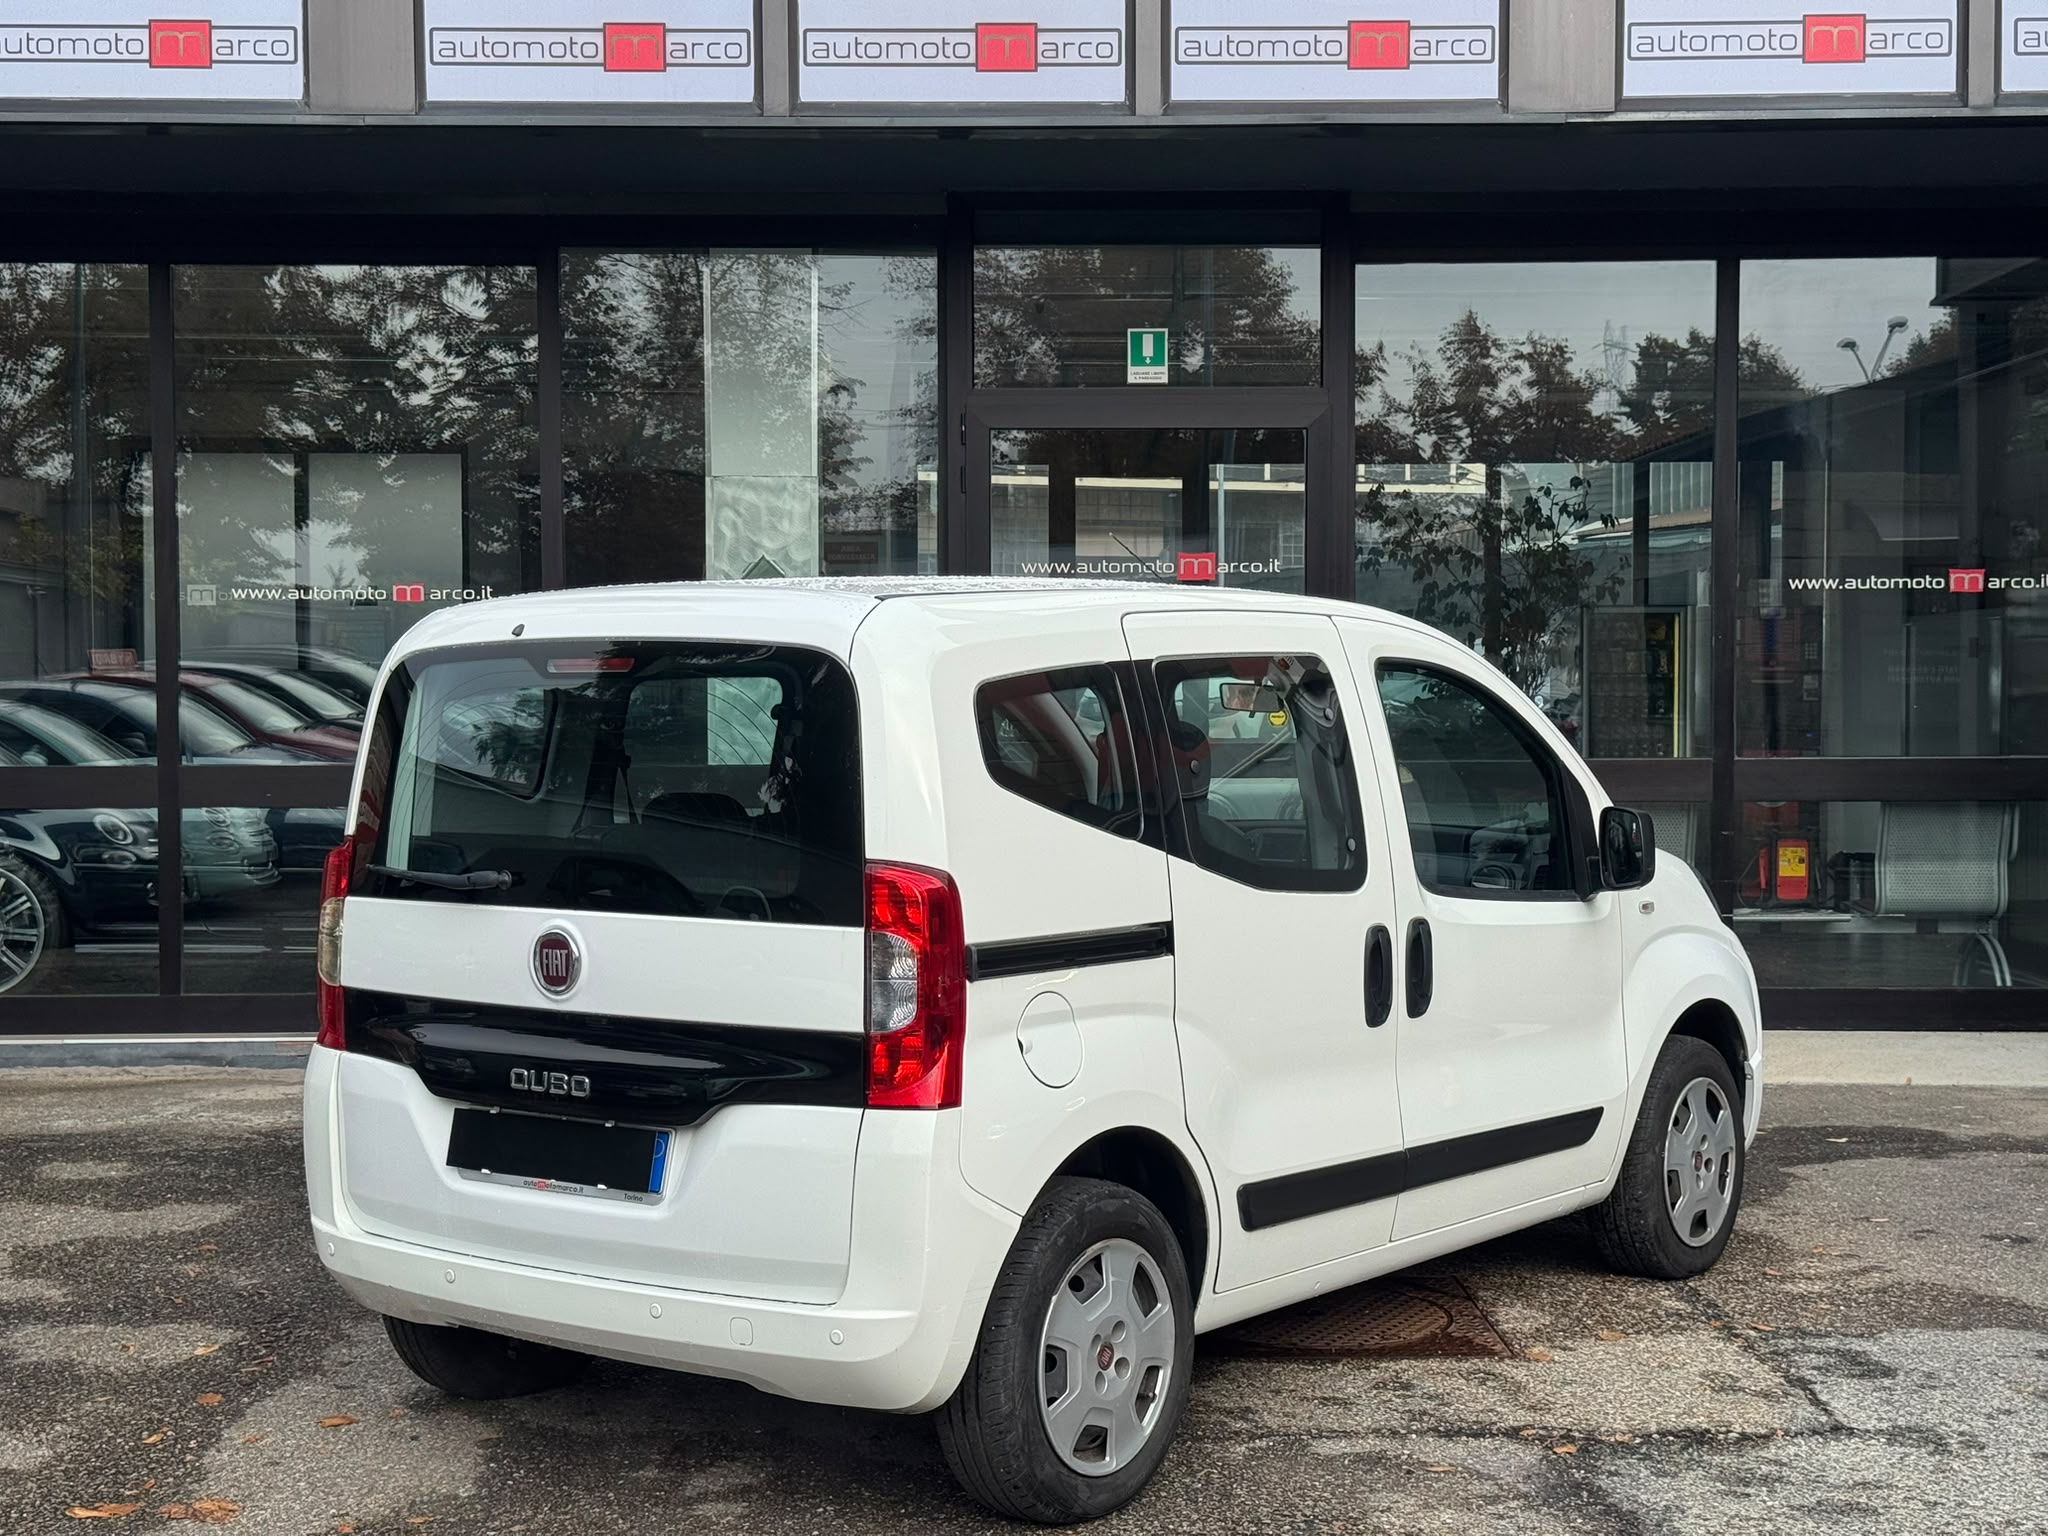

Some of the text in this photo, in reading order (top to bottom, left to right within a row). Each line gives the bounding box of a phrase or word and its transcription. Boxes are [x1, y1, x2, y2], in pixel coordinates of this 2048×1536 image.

[542, 948, 568, 977] FIAT
[509, 1068, 591, 1097] QUBO
[624, 1193, 644, 1202] Torino
